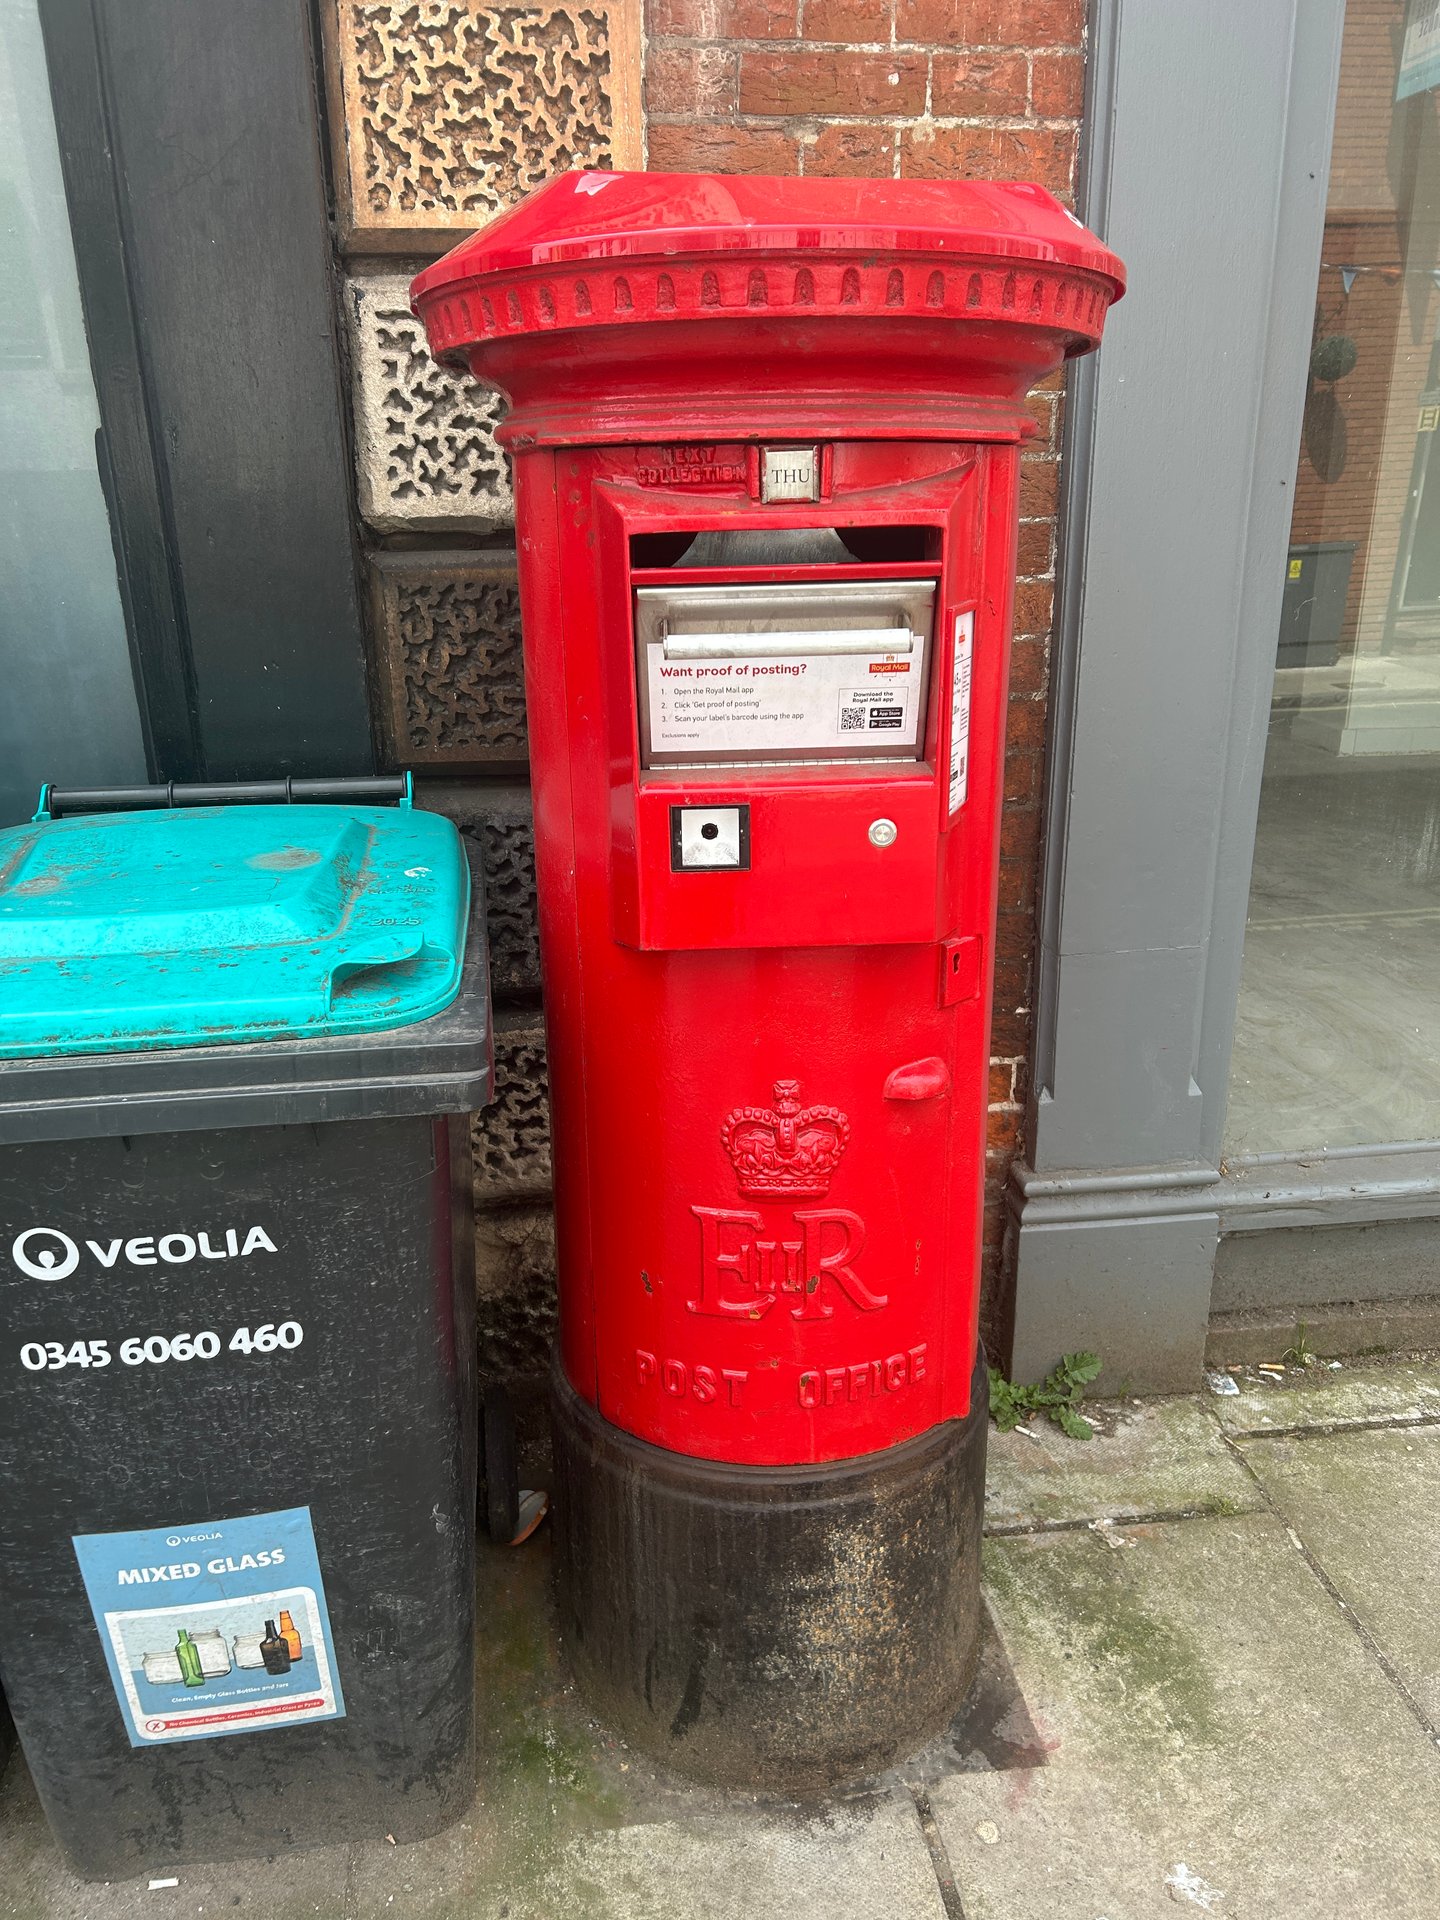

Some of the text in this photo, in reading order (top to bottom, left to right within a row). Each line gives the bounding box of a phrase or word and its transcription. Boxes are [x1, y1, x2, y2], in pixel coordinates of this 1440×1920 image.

[663, 447, 716, 464] NEXT
[637, 464, 746, 483] COLLECTION
[772, 468, 811, 484] THU
[660, 664, 807, 679] Want proof of posting?
[673, 687, 692, 697] Open
[693, 687, 704, 695] the
[705, 686, 724, 696] Royal
[725, 686, 740, 694] Mail
[741, 687, 754, 695] app
[674, 701, 691, 709] Click
[706, 700, 725, 709] proof
[726, 700, 733, 708] of
[692, 715, 708, 723] your
[731, 713, 759, 721] barcode
[759, 713, 779, 721] using
[85, 1226, 278, 1267] VEOLIA
[20, 1321, 304, 1370] 0345 6060 460
[636, 1343, 927, 1409] POST OFFICE
[182, 1532, 223, 1544] VEOLIA
[118, 1548, 286, 1585] MIXED GLASS
[193, 1693, 217, 1701] Empty
[217, 1690, 236, 1698] Glass
[236, 1687, 261, 1696] Bottles
[261, 1683, 275, 1691] and
